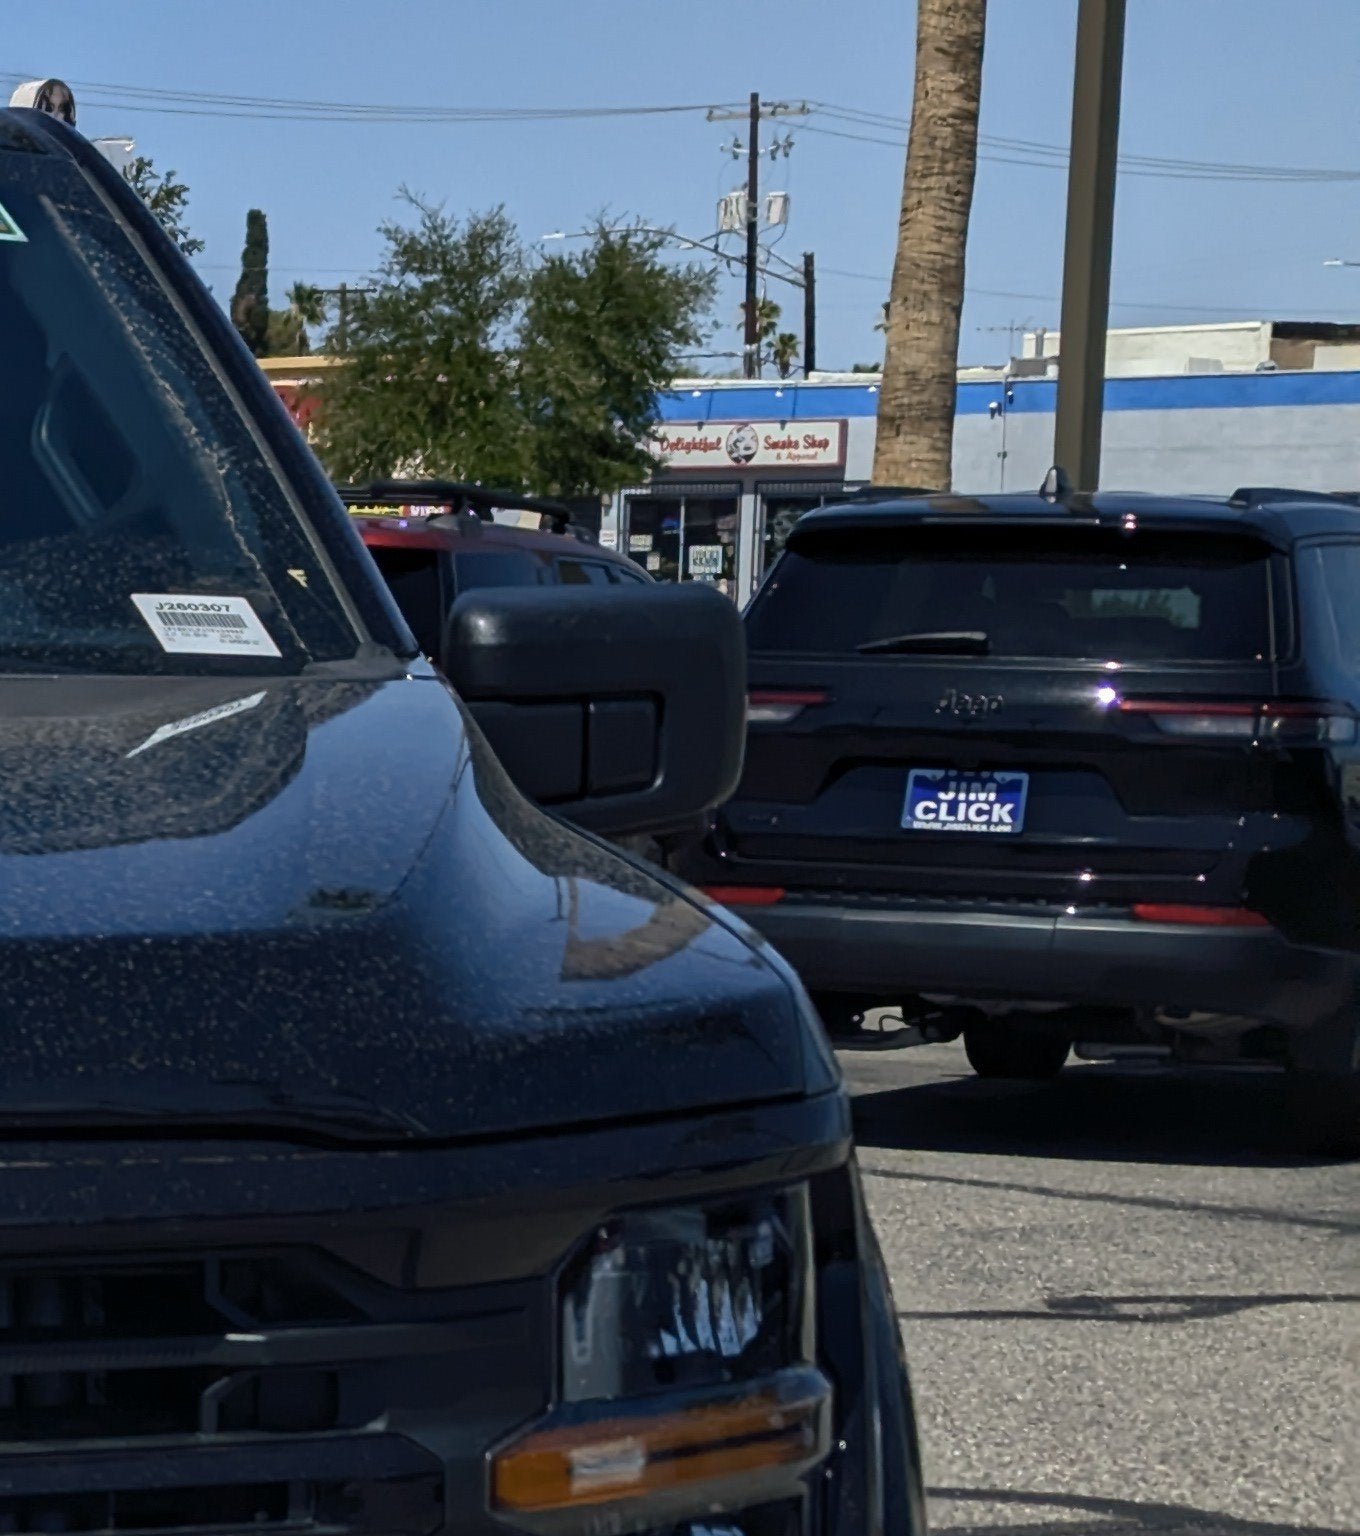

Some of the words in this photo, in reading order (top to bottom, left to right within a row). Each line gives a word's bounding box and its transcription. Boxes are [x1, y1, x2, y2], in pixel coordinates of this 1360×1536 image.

[660, 436, 722, 454] Delightful
[764, 435, 799, 450] Smoke
[803, 434, 830, 451] Shop
[937, 781, 998, 801] JIM
[914, 800, 1015, 823] CLICK
